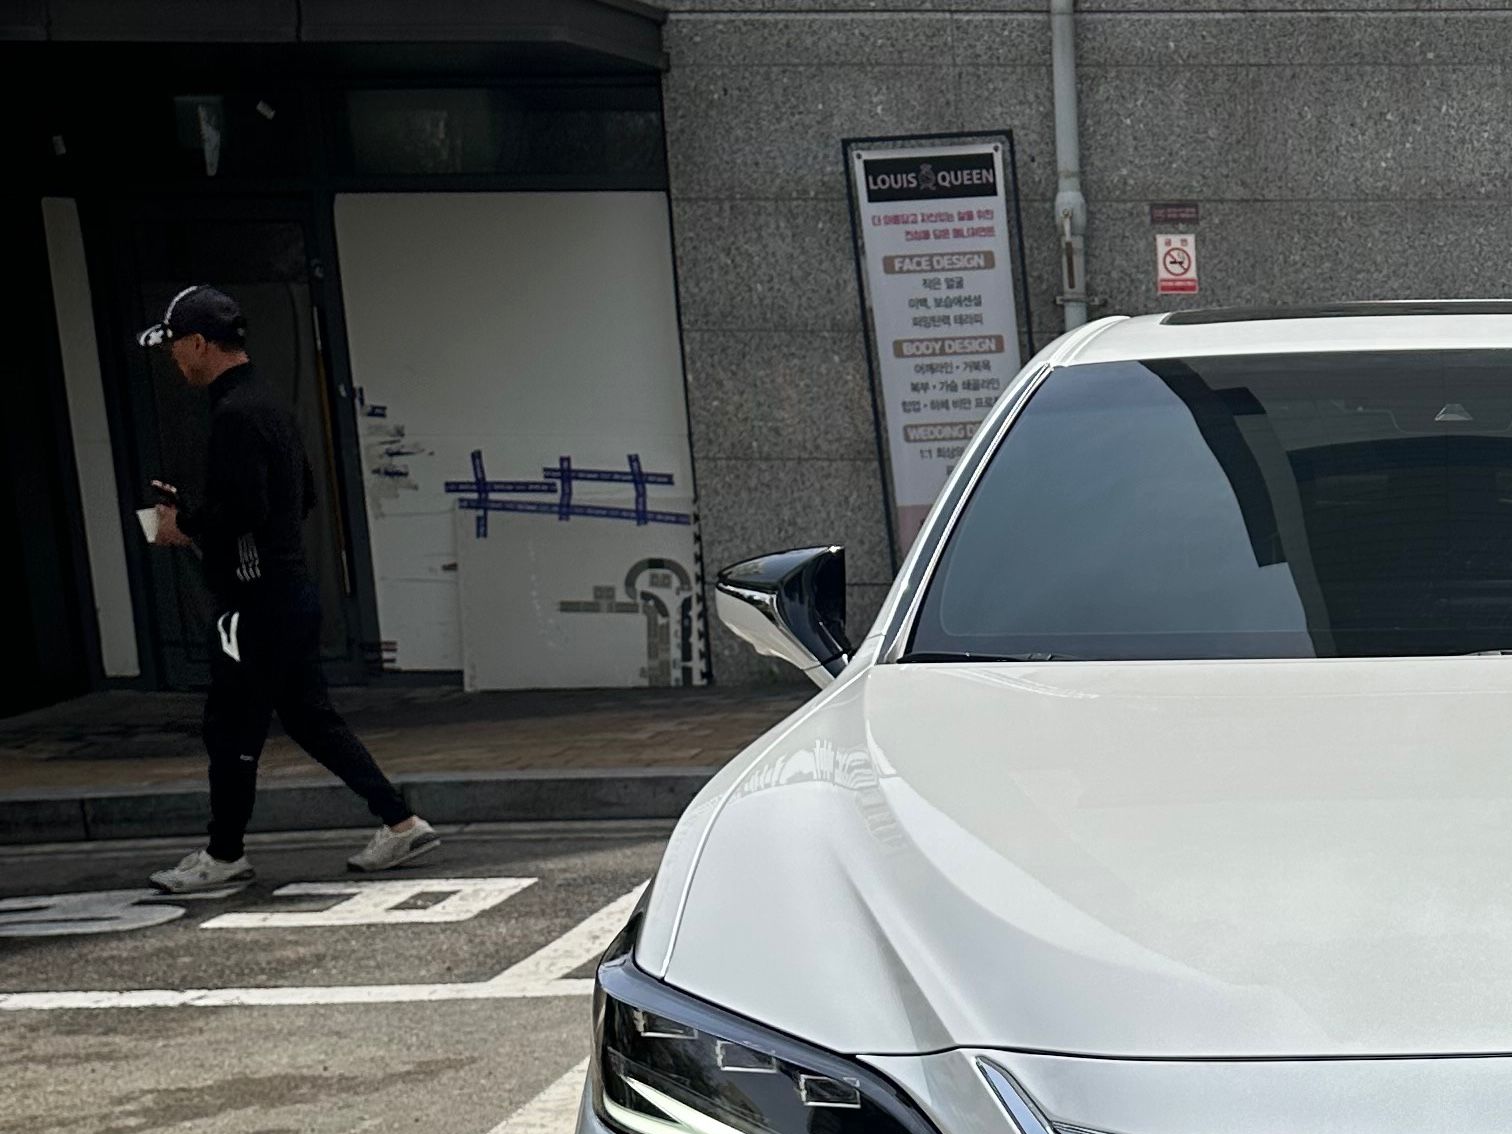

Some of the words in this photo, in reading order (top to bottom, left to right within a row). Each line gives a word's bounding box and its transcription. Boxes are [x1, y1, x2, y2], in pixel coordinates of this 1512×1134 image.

[868, 172, 918, 190] LOUIS
[937, 168, 994, 187] QUEEN
[894, 256, 932, 272] FACE
[932, 254, 985, 270] DESIGN
[902, 340, 944, 355] BODY
[944, 338, 996, 353] DESIGN
